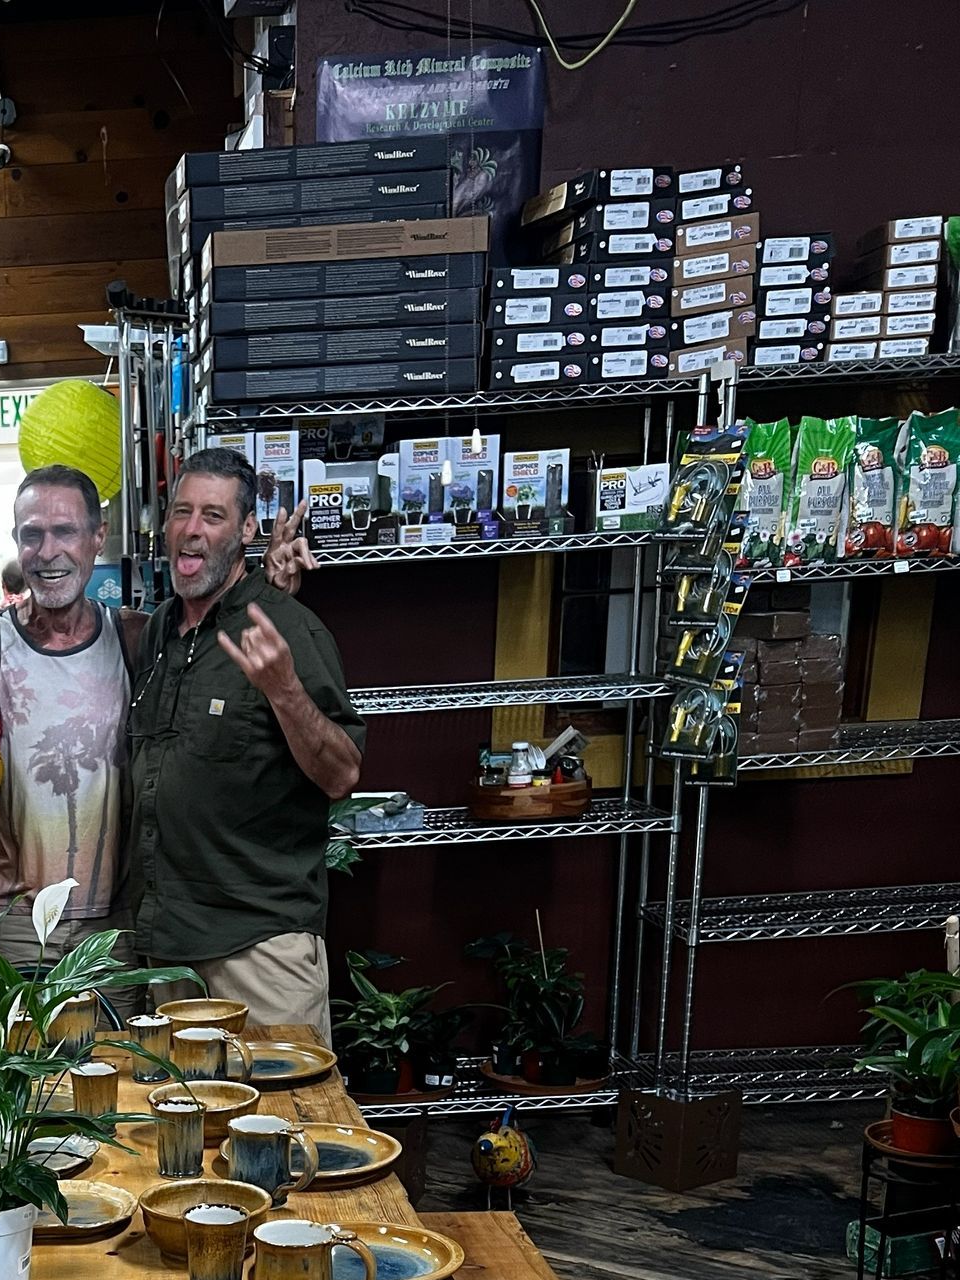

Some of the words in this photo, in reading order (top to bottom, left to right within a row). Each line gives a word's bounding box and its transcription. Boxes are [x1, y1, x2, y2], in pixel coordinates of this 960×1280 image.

[332, 64, 381, 79] Calcium
[384, 60, 413, 77] Rich
[416, 56, 466, 76] Mineral
[471, 54, 532, 71] Composite
[366, 122, 401, 133] Research
[413, 119, 465, 132] Development
[468, 117, 495, 128] Center
[0, 394, 38, 428] EX
[601, 481, 626, 490] PRO
[309, 493, 342, 507] PRO
[311, 515, 341, 523] GOPHER
